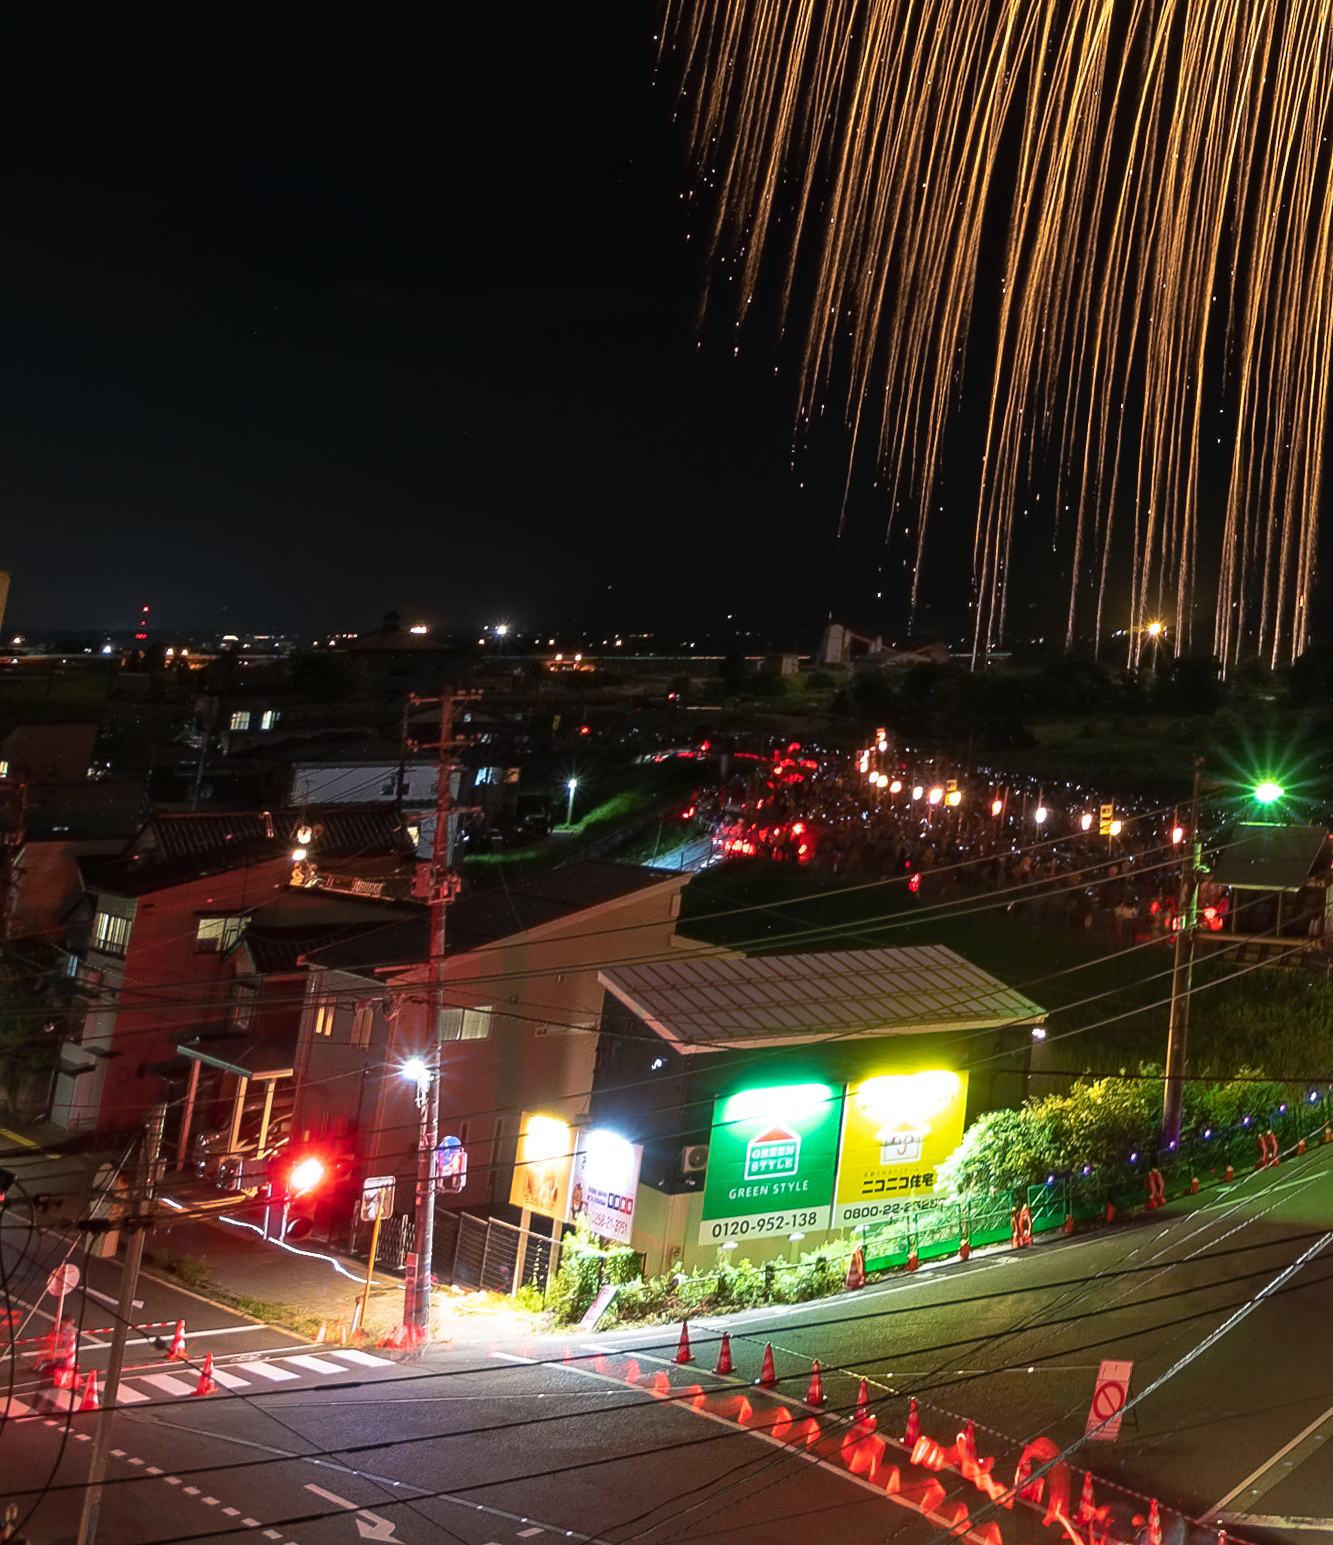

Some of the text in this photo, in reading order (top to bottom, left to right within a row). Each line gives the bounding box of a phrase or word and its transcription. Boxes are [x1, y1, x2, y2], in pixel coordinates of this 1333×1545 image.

[751, 1145, 795, 1160] GREEN
[751, 1157, 794, 1172] STYLE
[728, 1180, 809, 1201] GREEN STYLE
[861, 1172, 935, 1195] ニコニコ住宅
[712, 1211, 817, 1239] 0120-952-138
